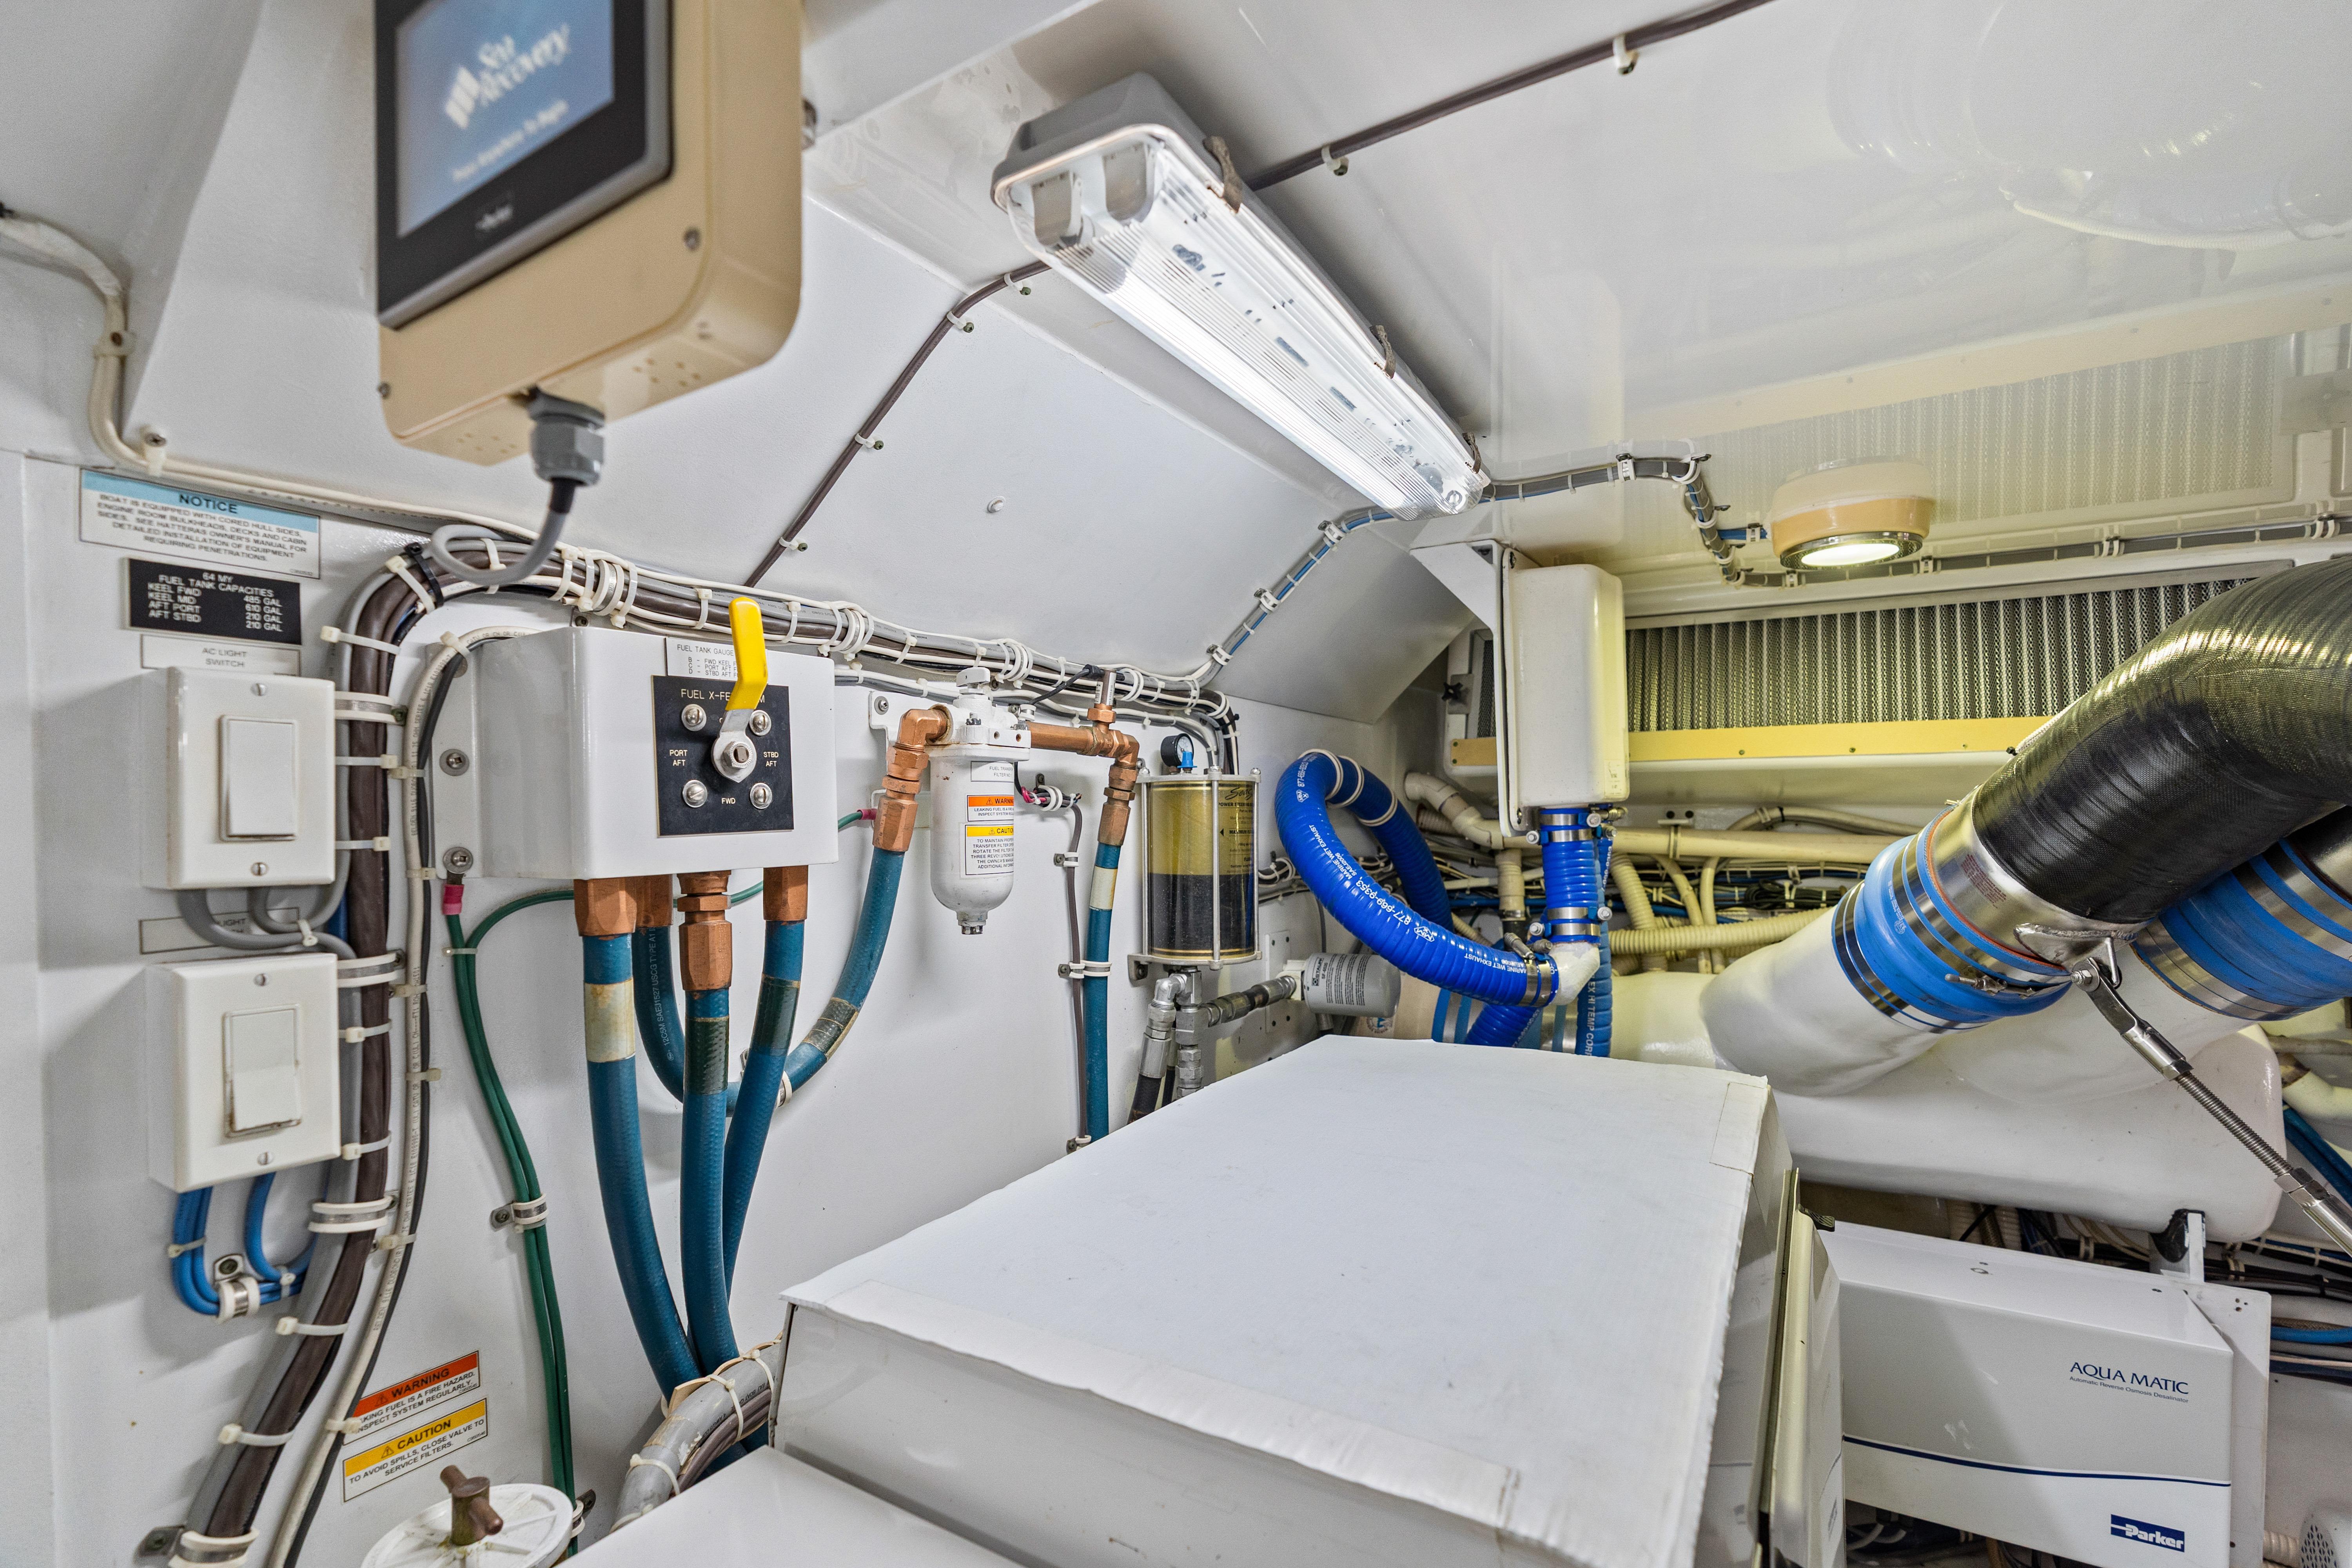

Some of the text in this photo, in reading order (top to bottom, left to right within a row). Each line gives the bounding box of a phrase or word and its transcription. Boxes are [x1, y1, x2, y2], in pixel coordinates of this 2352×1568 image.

[100, 494, 127, 504] BOAT
[142, 502, 191, 516] EQUIPPED
[192, 511, 215, 520] WITH
[218, 516, 249, 527] CORED
[252, 522, 273, 532] HULL
[276, 527, 301, 537] SIDES,
[179, 494, 238, 514] NOTICE
[98, 502, 133, 513] ENGINE
[138, 510, 166, 519] ROOM
[230, 527, 260, 537] DECKS
[281, 537, 307, 545] CABIN
[136, 517, 153, 526] SEE
[157, 522, 207, 535] HATTERAS
[209, 532, 250, 543] OWNER'S
[253, 539, 288, 550] MANUAL
[290, 545, 307, 553] FOR
[113, 522, 161, 535] DETAILED
[163, 531, 229, 547] INSTALLATION
[245, 544, 294, 558] EQUIPMENT
[144, 535, 267, 561] REQUIRING PENETRATIONS.
[158, 574, 275, 598] FUEL TANK CAPACITIES
[202, 572, 234, 583] 64 MY
[147, 582, 283, 607] KEEL FWD 485 GAL
[147, 591, 283, 616] KEEL MID 610 GAL
[148, 600, 283, 624] AFT PORT 210 GAL
[148, 610, 284, 632] AFT STBD 210 GAL
[205, 658, 245, 668] SWITCH
[218, 649, 247, 658] LIGHT
[713, 648, 734, 656] GAUGE
[681, 689, 704, 700] FUEL
[1308, 824, 1353, 880] MARINE WET EXHAUST
[1356, 879, 1412, 926] 877-669-9353
[649, 933, 656, 942] A1
[650, 964, 659, 986] USCG
[1464, 953, 1506, 971] WET EXHAUST
[653, 987, 664, 1022] SAEJ1527
[1587, 995, 1596, 1031] HI TEMP
[661, 1023, 670, 1046] 12C5M
[391, 1368, 450, 1398] WARNING
[2070, 1362, 2189, 1395] AQUA MATIC
[2070, 1376, 2189, 1403] Automatic Reverse Osmosis Desalinator
[386, 1401, 405, 1414] FUEL
[425, 1386, 442, 1396] FIRE
[443, 1372, 475, 1388] HAZARD.
[745, 1389, 756, 1399] BOAT
[358, 1380, 473, 1433] NSPECT SYSTEM REGULARLY.
[397, 1419, 451, 1450] CAUTION
[350, 1419, 484, 1484] TO AVOID SPILLS, CLOSE VALVE TO
[385, 1442, 454, 1477] SERVICE FILTERS.
[2125, 1523, 2184, 1549] Parker
